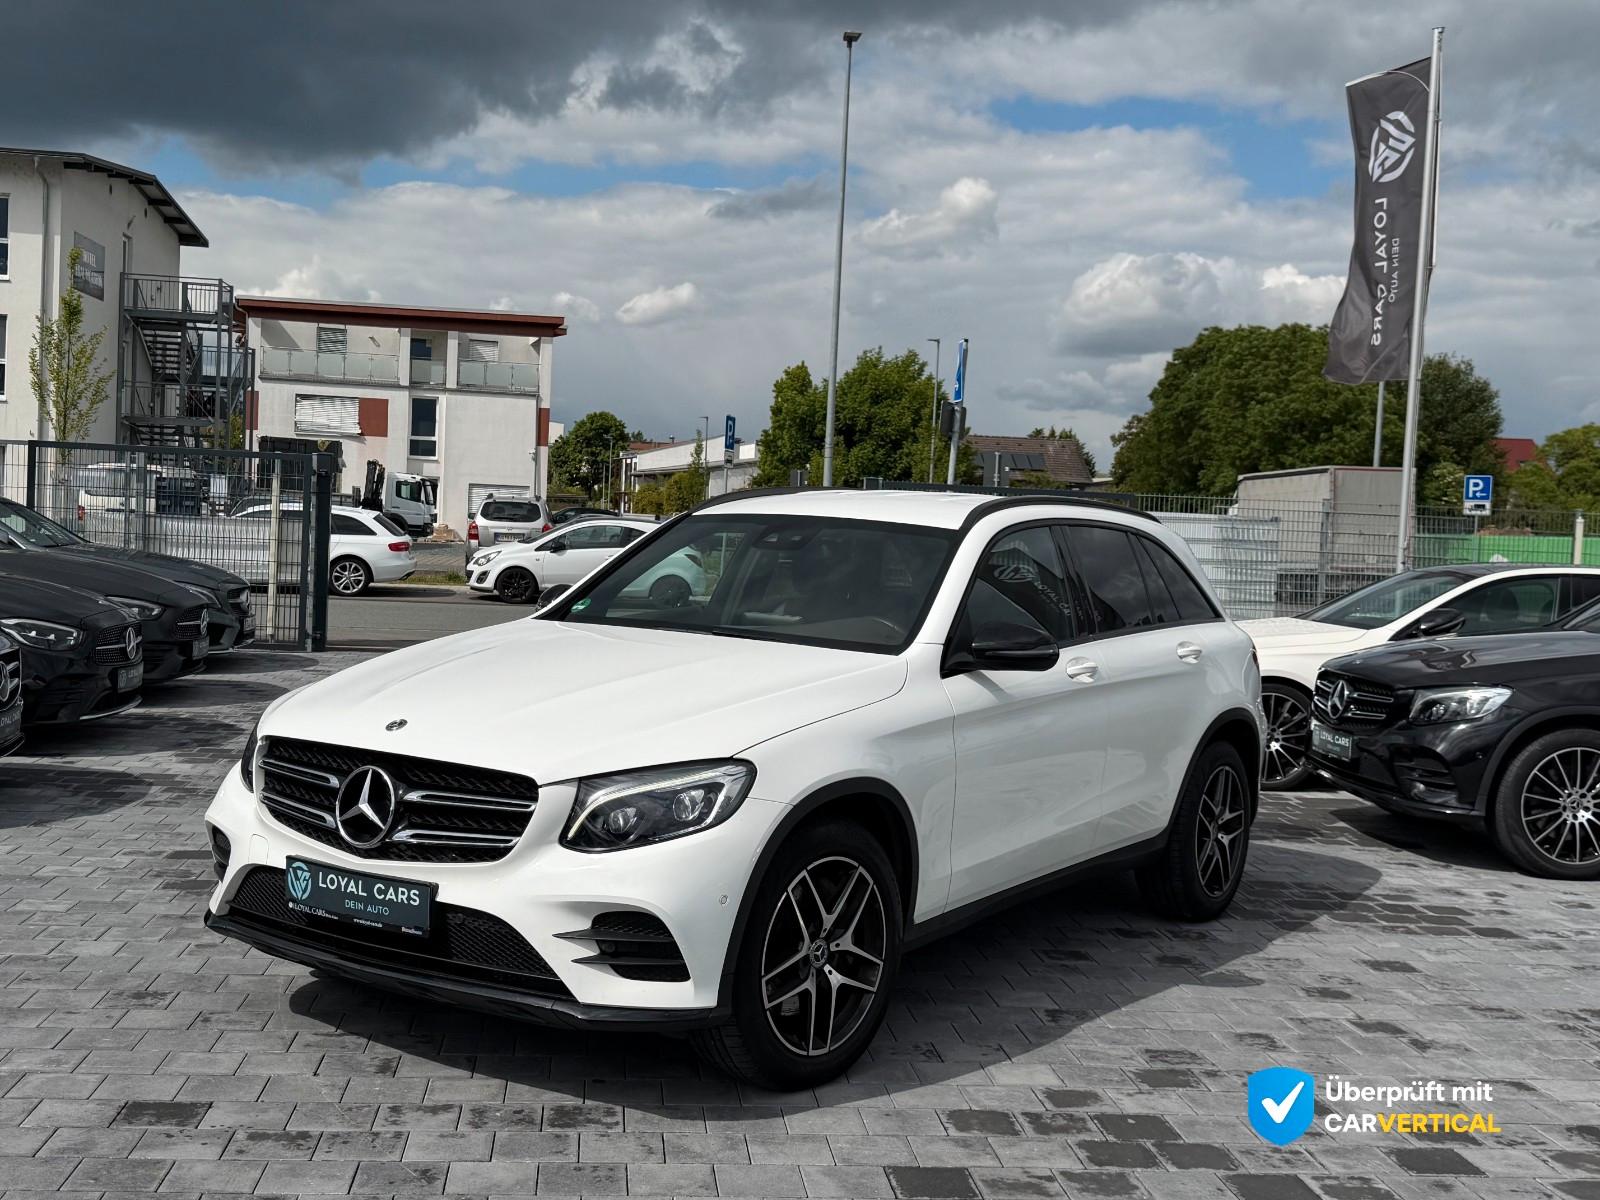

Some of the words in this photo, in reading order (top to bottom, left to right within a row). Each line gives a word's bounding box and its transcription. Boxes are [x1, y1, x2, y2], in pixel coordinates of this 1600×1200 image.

[727, 420, 734, 446] P
[1469, 478, 1484, 498] P
[1334, 735, 1350, 747] CARS
[319, 871, 367, 897] LOYAL
[373, 883, 420, 906] CARS
[345, 899, 364, 910] DEIN
[366, 904, 390, 916] AUTO
